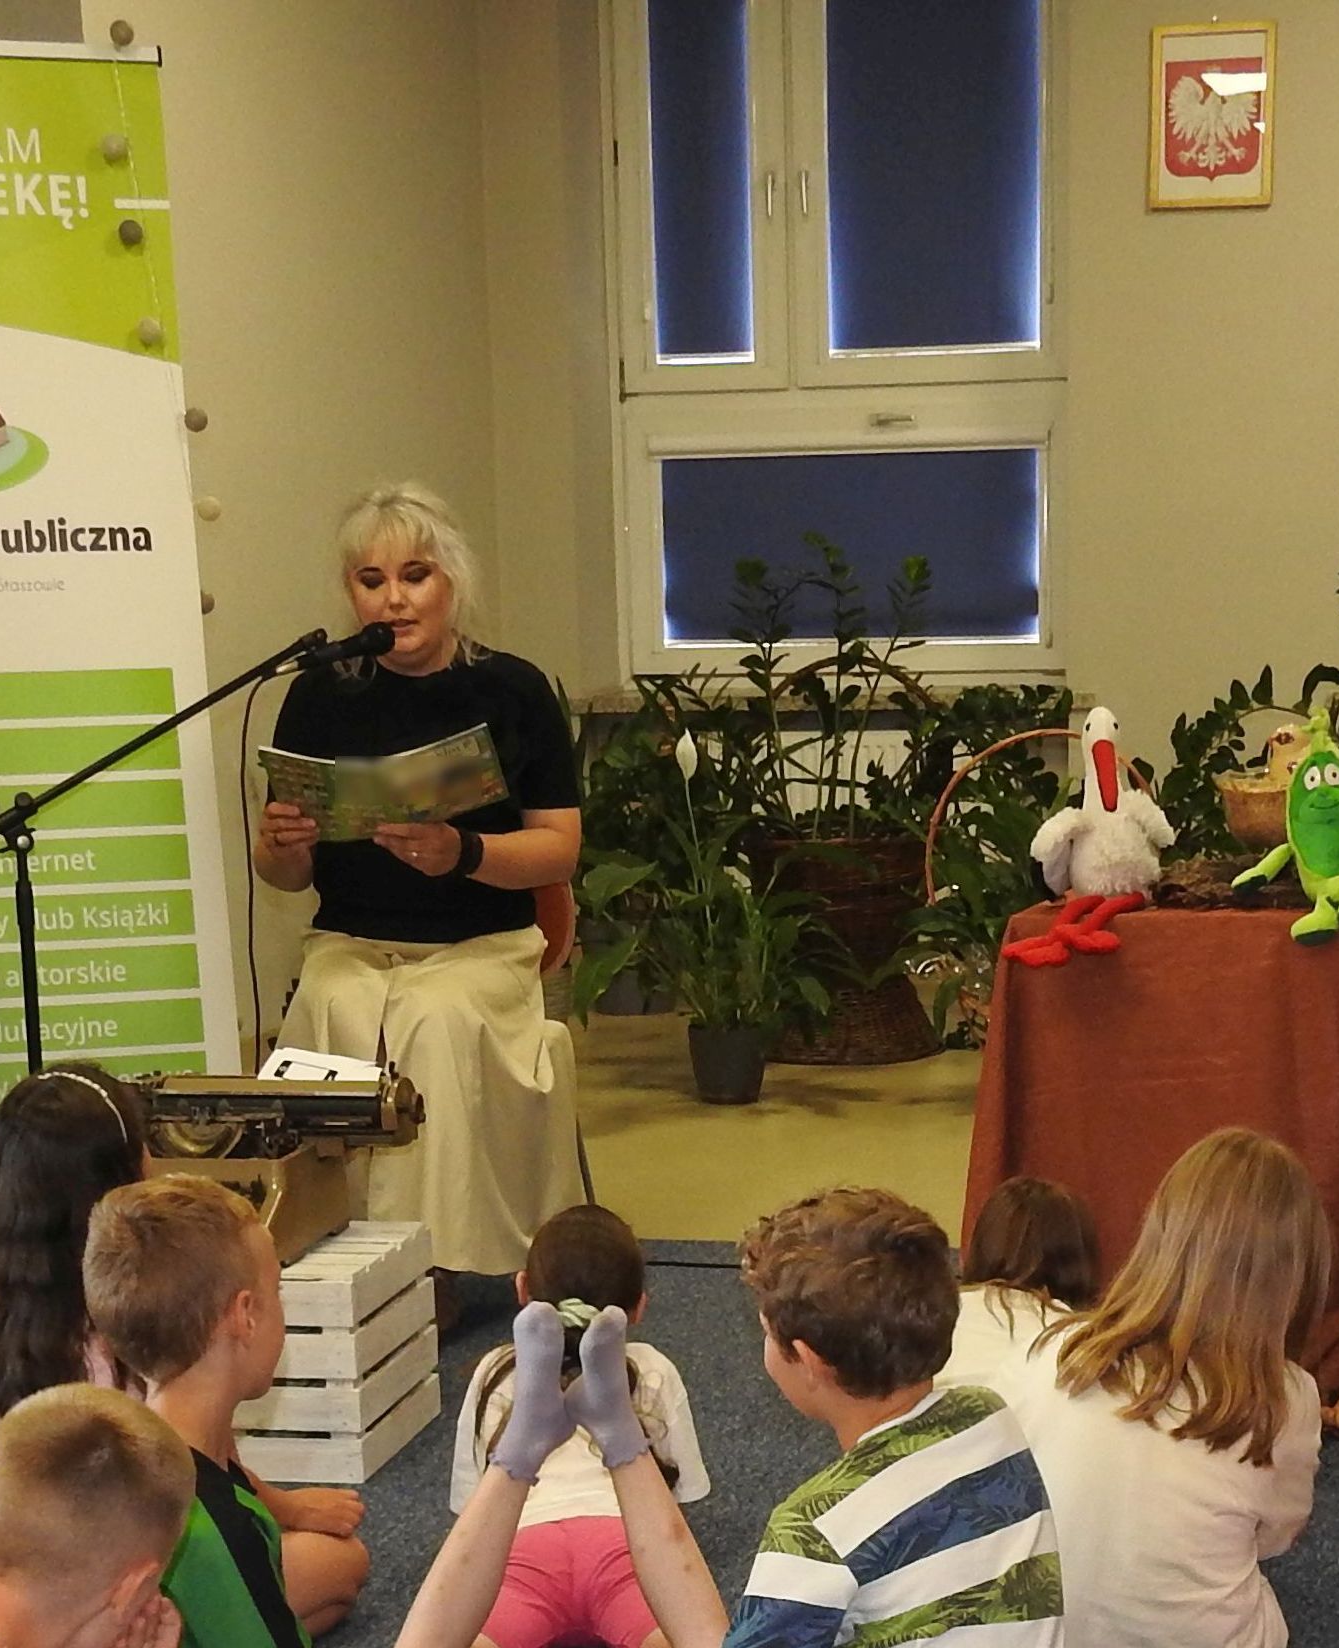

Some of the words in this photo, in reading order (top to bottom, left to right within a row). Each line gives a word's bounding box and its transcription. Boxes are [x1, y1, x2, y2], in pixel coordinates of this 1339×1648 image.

[34, 905, 75, 932] lub
[82, 902, 170, 933] Książki
[4, 959, 128, 988] atorskie
